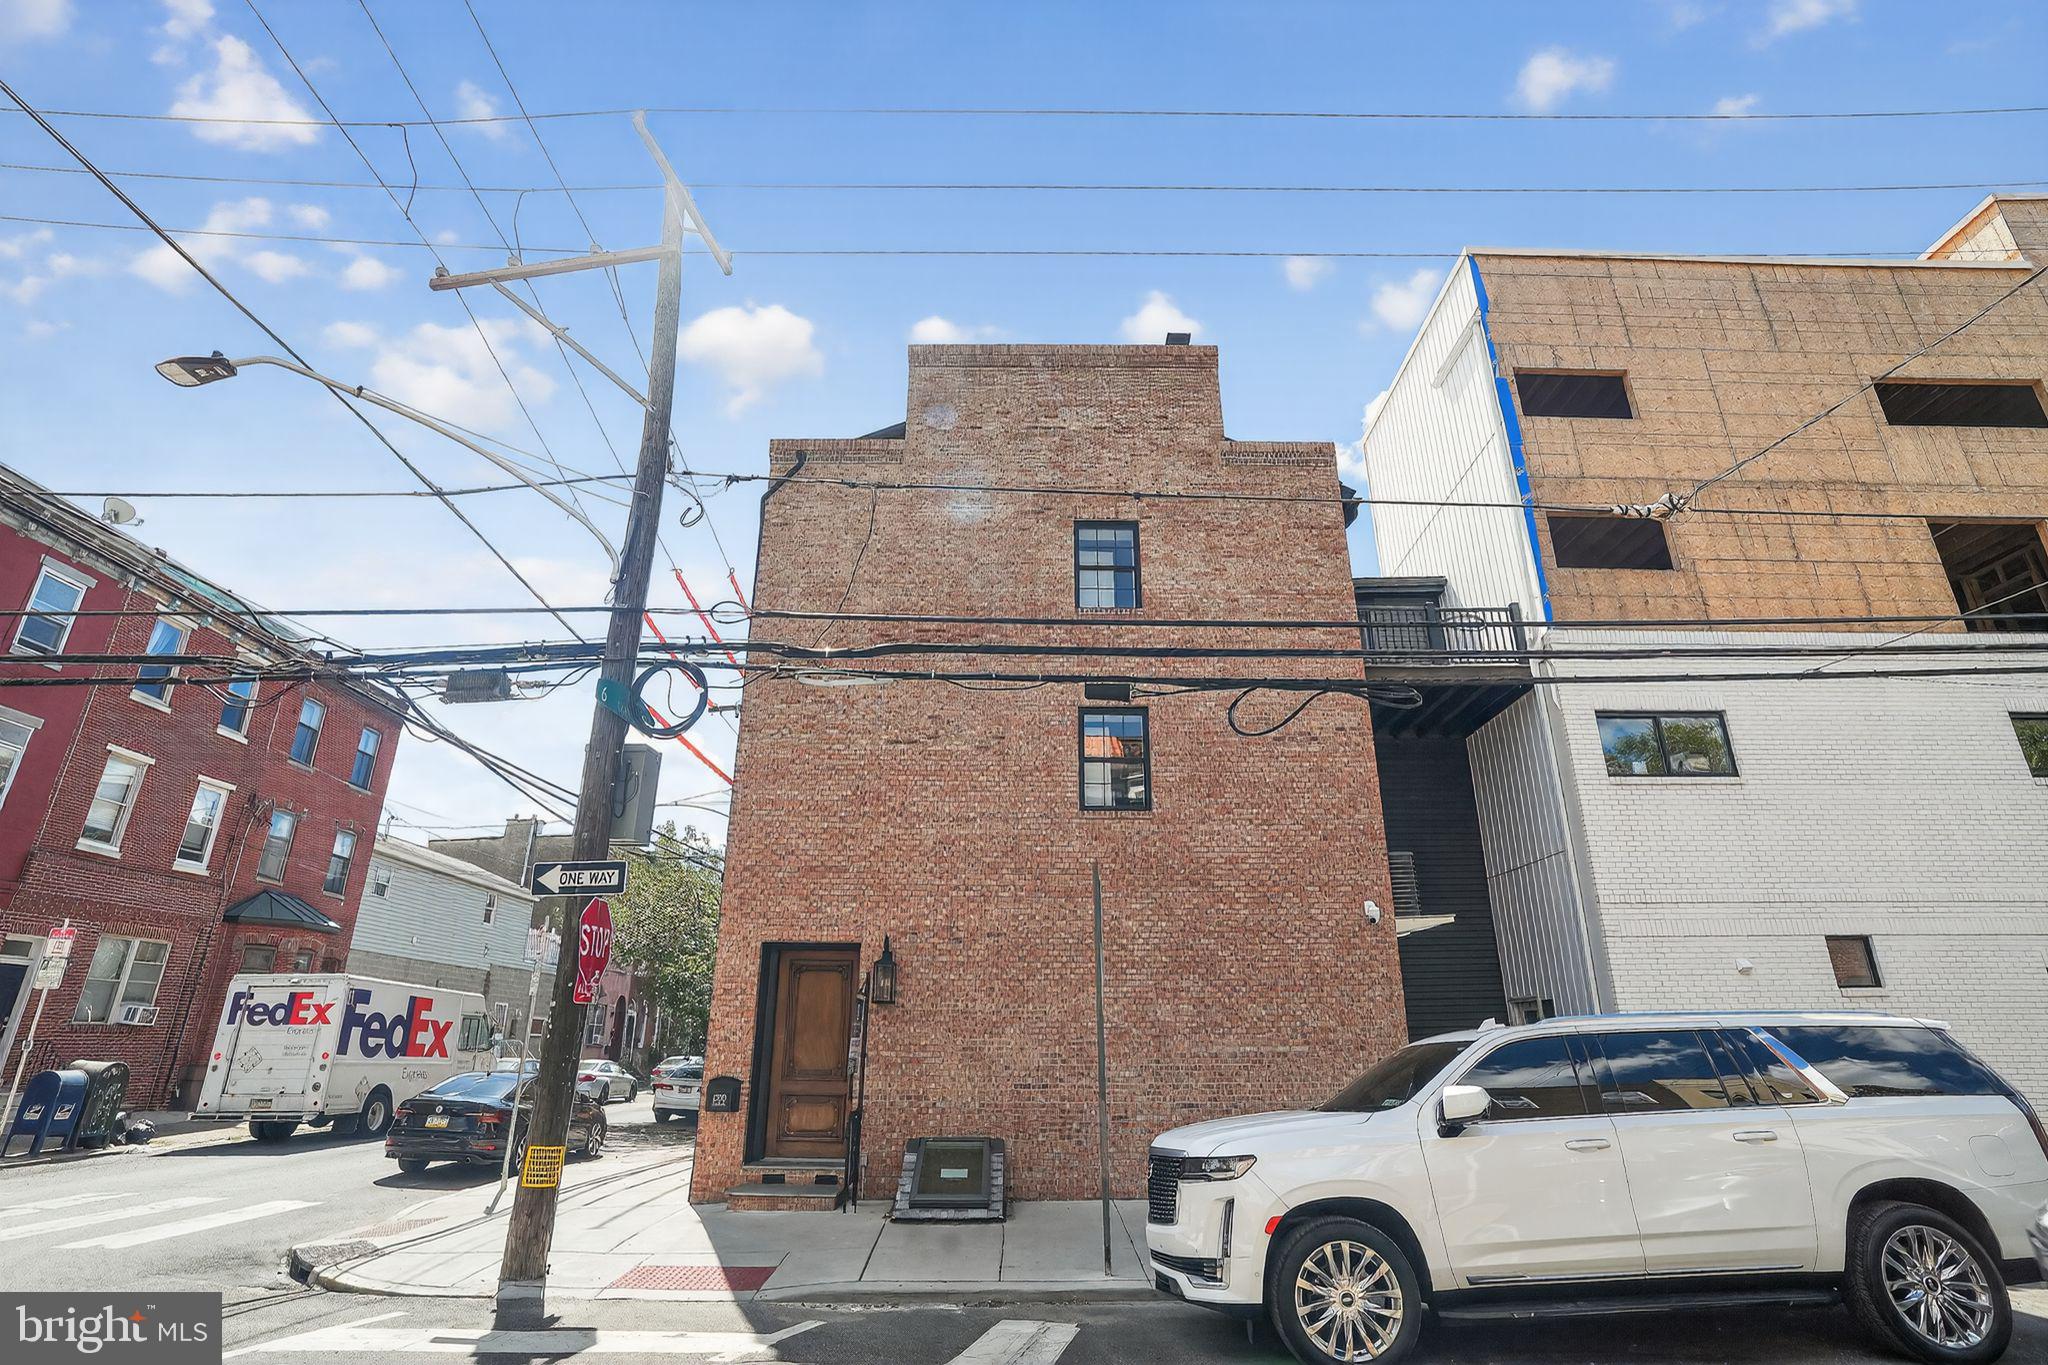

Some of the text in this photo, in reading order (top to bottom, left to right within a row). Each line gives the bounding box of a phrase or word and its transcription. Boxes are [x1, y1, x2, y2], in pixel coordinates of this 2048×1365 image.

[560, 871, 615, 886] ONE WAY
[580, 923, 611, 959] STOP
[227, 991, 337, 1027] FedEx
[336, 987, 454, 1059] FedEx
